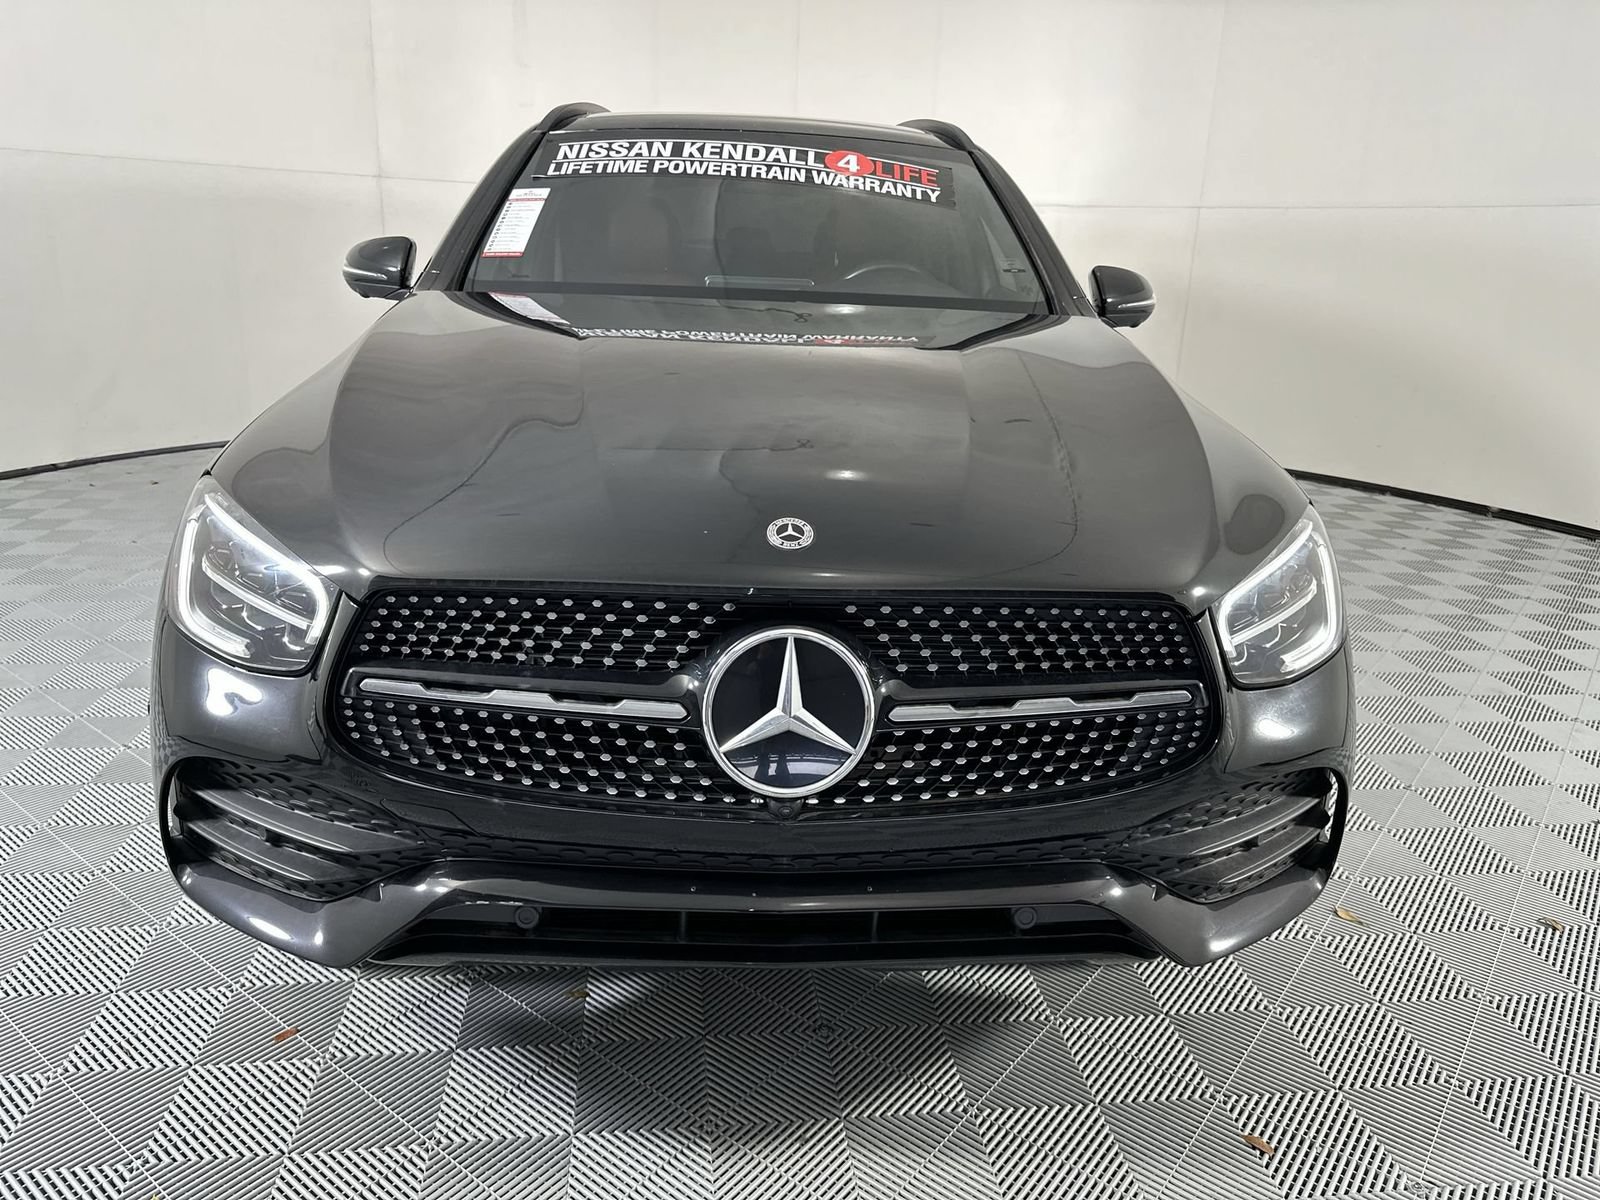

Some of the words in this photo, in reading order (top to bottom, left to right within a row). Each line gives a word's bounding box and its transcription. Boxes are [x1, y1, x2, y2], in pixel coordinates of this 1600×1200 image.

[546, 160, 649, 176] LIFETIME
[652, 160, 807, 183] POWERTRAIN
[811, 169, 941, 203] WARRANTY
[556, 141, 674, 160] NISSAN
[682, 142, 825, 168] KENDALL
[837, 154, 861, 173] 4
[875, 160, 939, 187] LIFE
